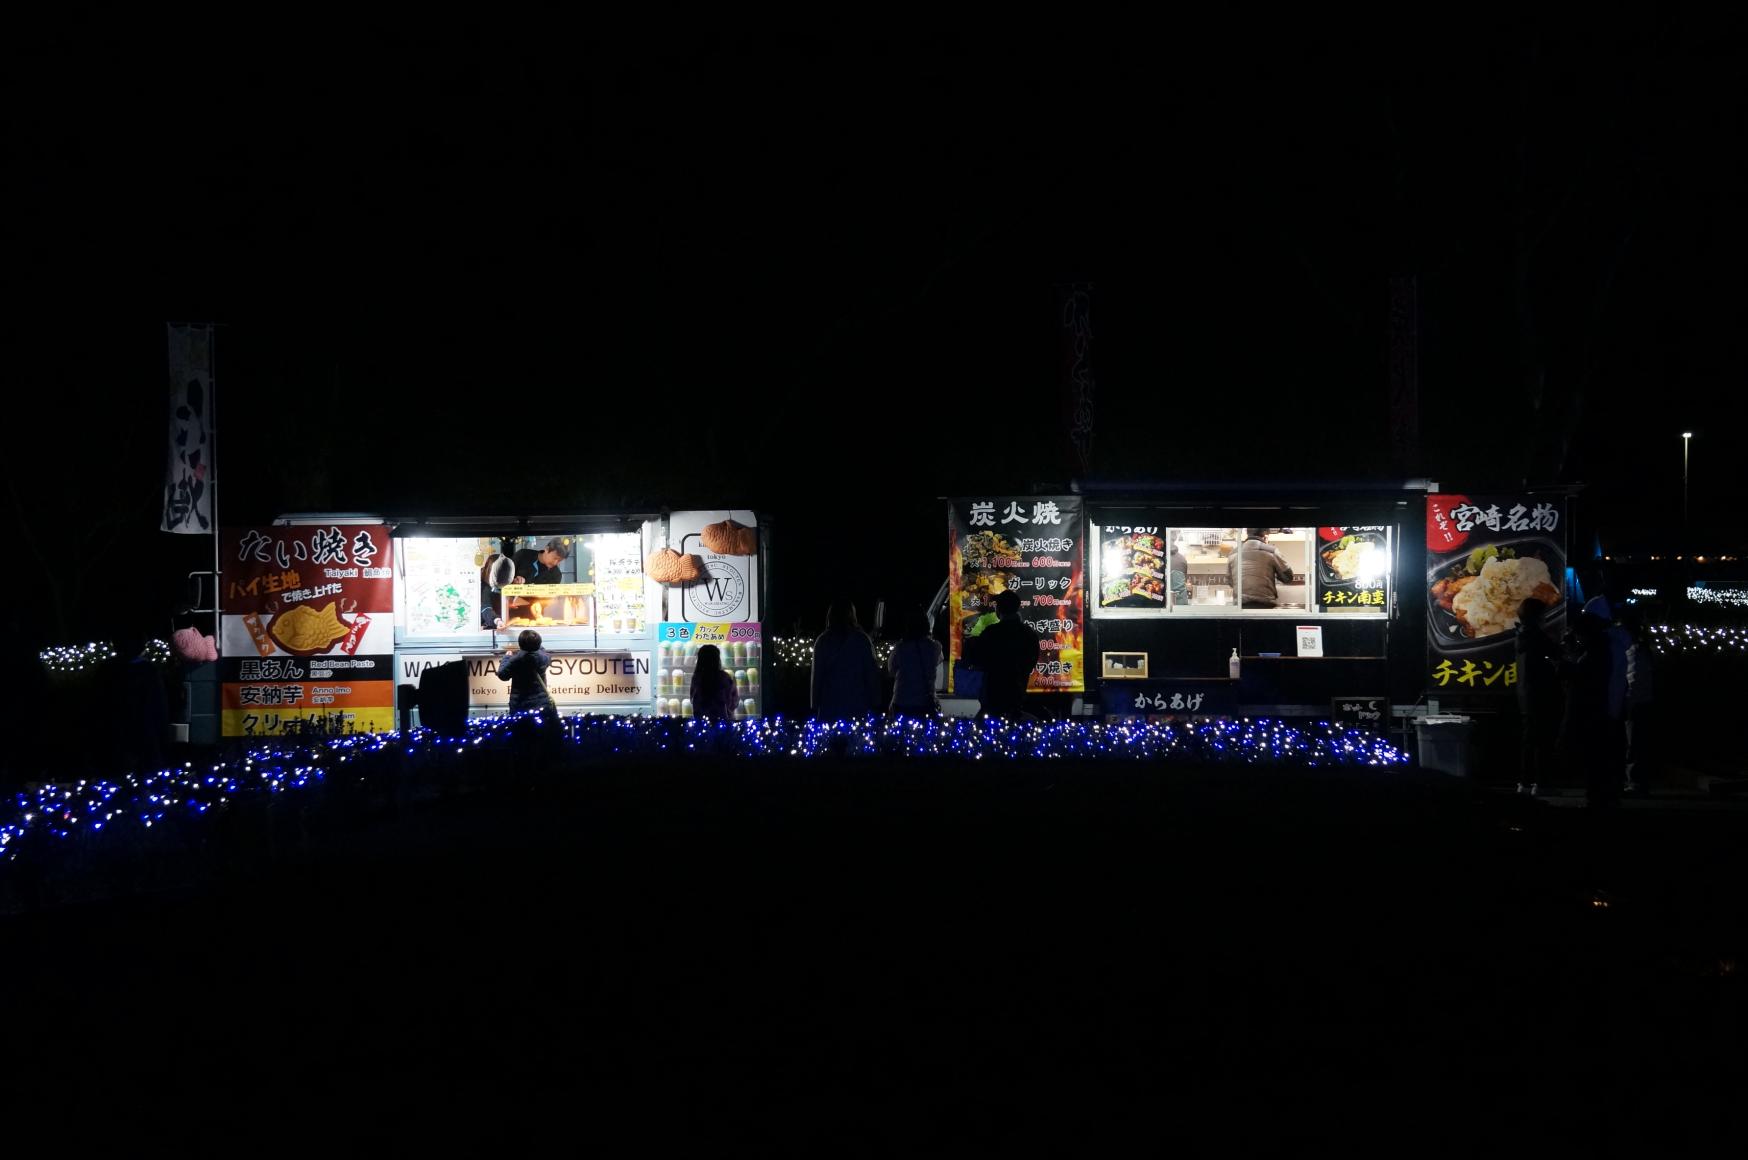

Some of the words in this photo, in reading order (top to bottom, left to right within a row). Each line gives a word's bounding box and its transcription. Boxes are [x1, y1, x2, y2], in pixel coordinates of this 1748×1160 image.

[969, 501, 1061, 526] 炭火焼
[1451, 503, 1559, 532] 宮崎名物
[238, 527, 378, 568] たい焼き
[1021, 538, 1073, 552] 炭火焼き
[1032, 557, 1053, 568] 600
[324, 568, 358, 578] Taiyaki
[1008, 577, 1072, 591] ガーリック
[281, 583, 343, 603] で焼き上げた
[1033, 595, 1054, 606] 700
[1323, 589, 1385, 605] チキン南蛮
[240, 660, 304, 680] 黒あん
[310, 660, 328, 668] Red
[329, 660, 350, 668] Bean
[350, 660, 375, 668] Paste
[549, 658, 649, 675] SYOUTEN
[241, 685, 304, 705] 安納芋
[312, 687, 335, 695] Anno
[472, 686, 497, 696] tokyo
[549, 685, 591, 695] atering
[1134, 692, 1204, 711] からあげ
